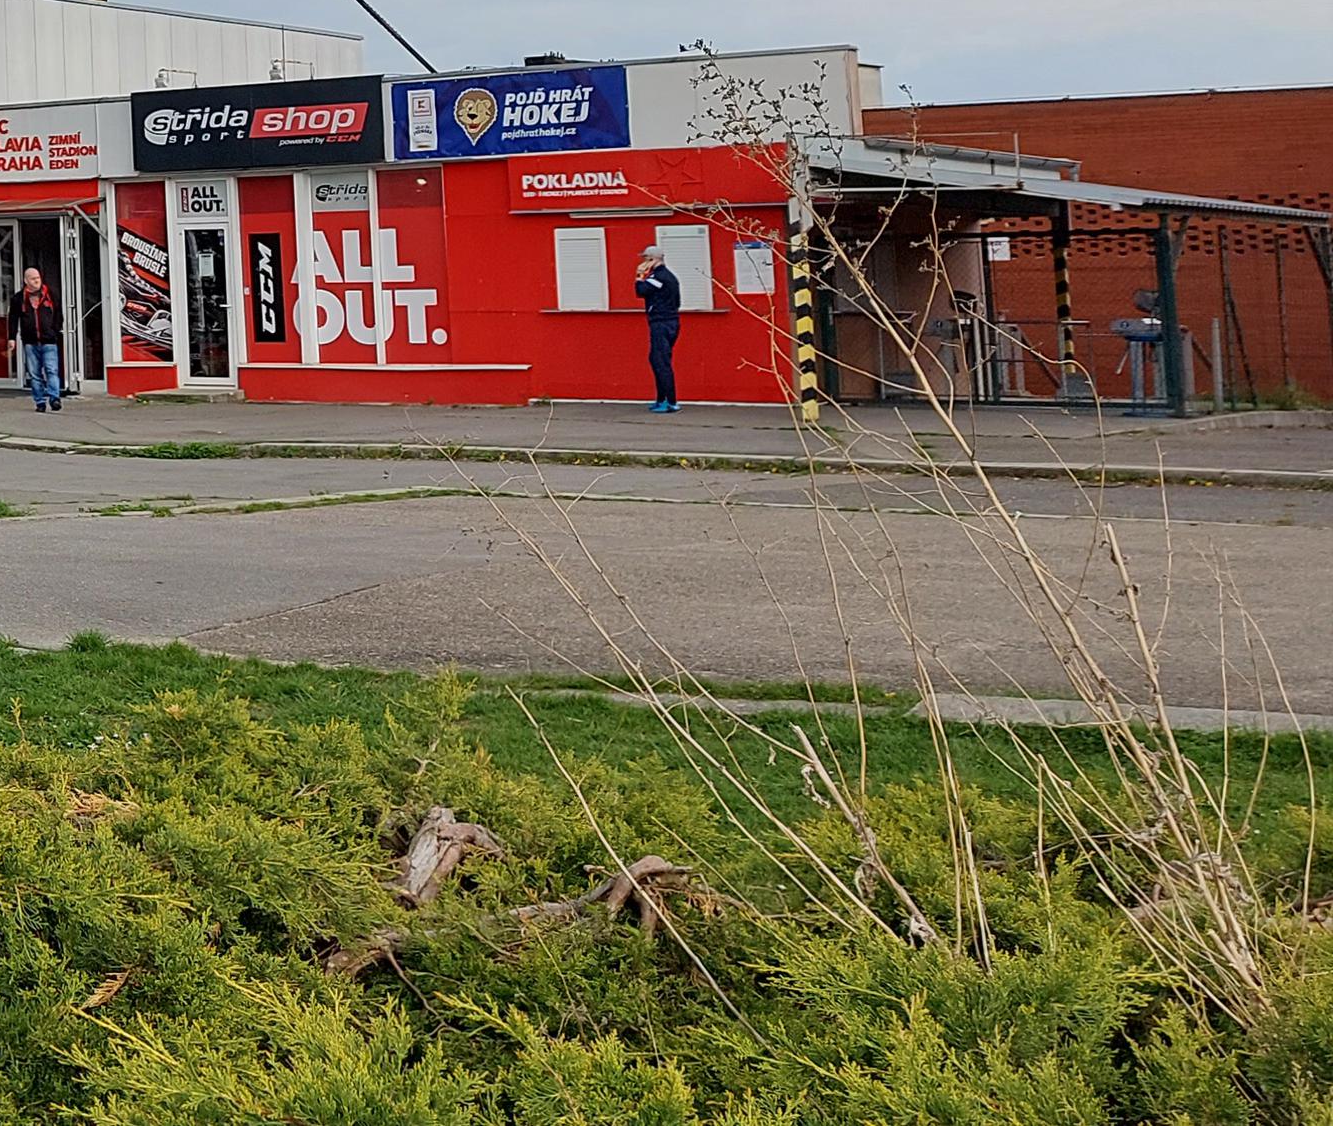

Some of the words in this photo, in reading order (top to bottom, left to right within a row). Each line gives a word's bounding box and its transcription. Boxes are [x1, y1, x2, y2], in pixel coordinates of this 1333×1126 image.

[505, 87, 546, 105] POJĎ
[548, 84, 593, 103] HRÁT
[261, 107, 355, 134] shop
[503, 101, 589, 127] HOKEJ
[48, 131, 81, 145] ZIMNÍ
[168, 130, 245, 146] sport
[278, 137, 313, 146] powered
[315, 136, 325, 145] by
[326, 134, 361, 142] CCM
[48, 146, 97, 158] STADION
[49, 158, 79, 170] EDEN
[522, 171, 627, 190] POKLADNA
[191, 186, 218, 198] ALL
[191, 199, 225, 212] OUT.
[121, 231, 168, 264] BROUSÍME
[290, 228, 416, 284] ALL
[133, 251, 167, 277] BRUSLE
[257, 242, 277, 334] CCM
[293, 288, 448, 346] OUT.
